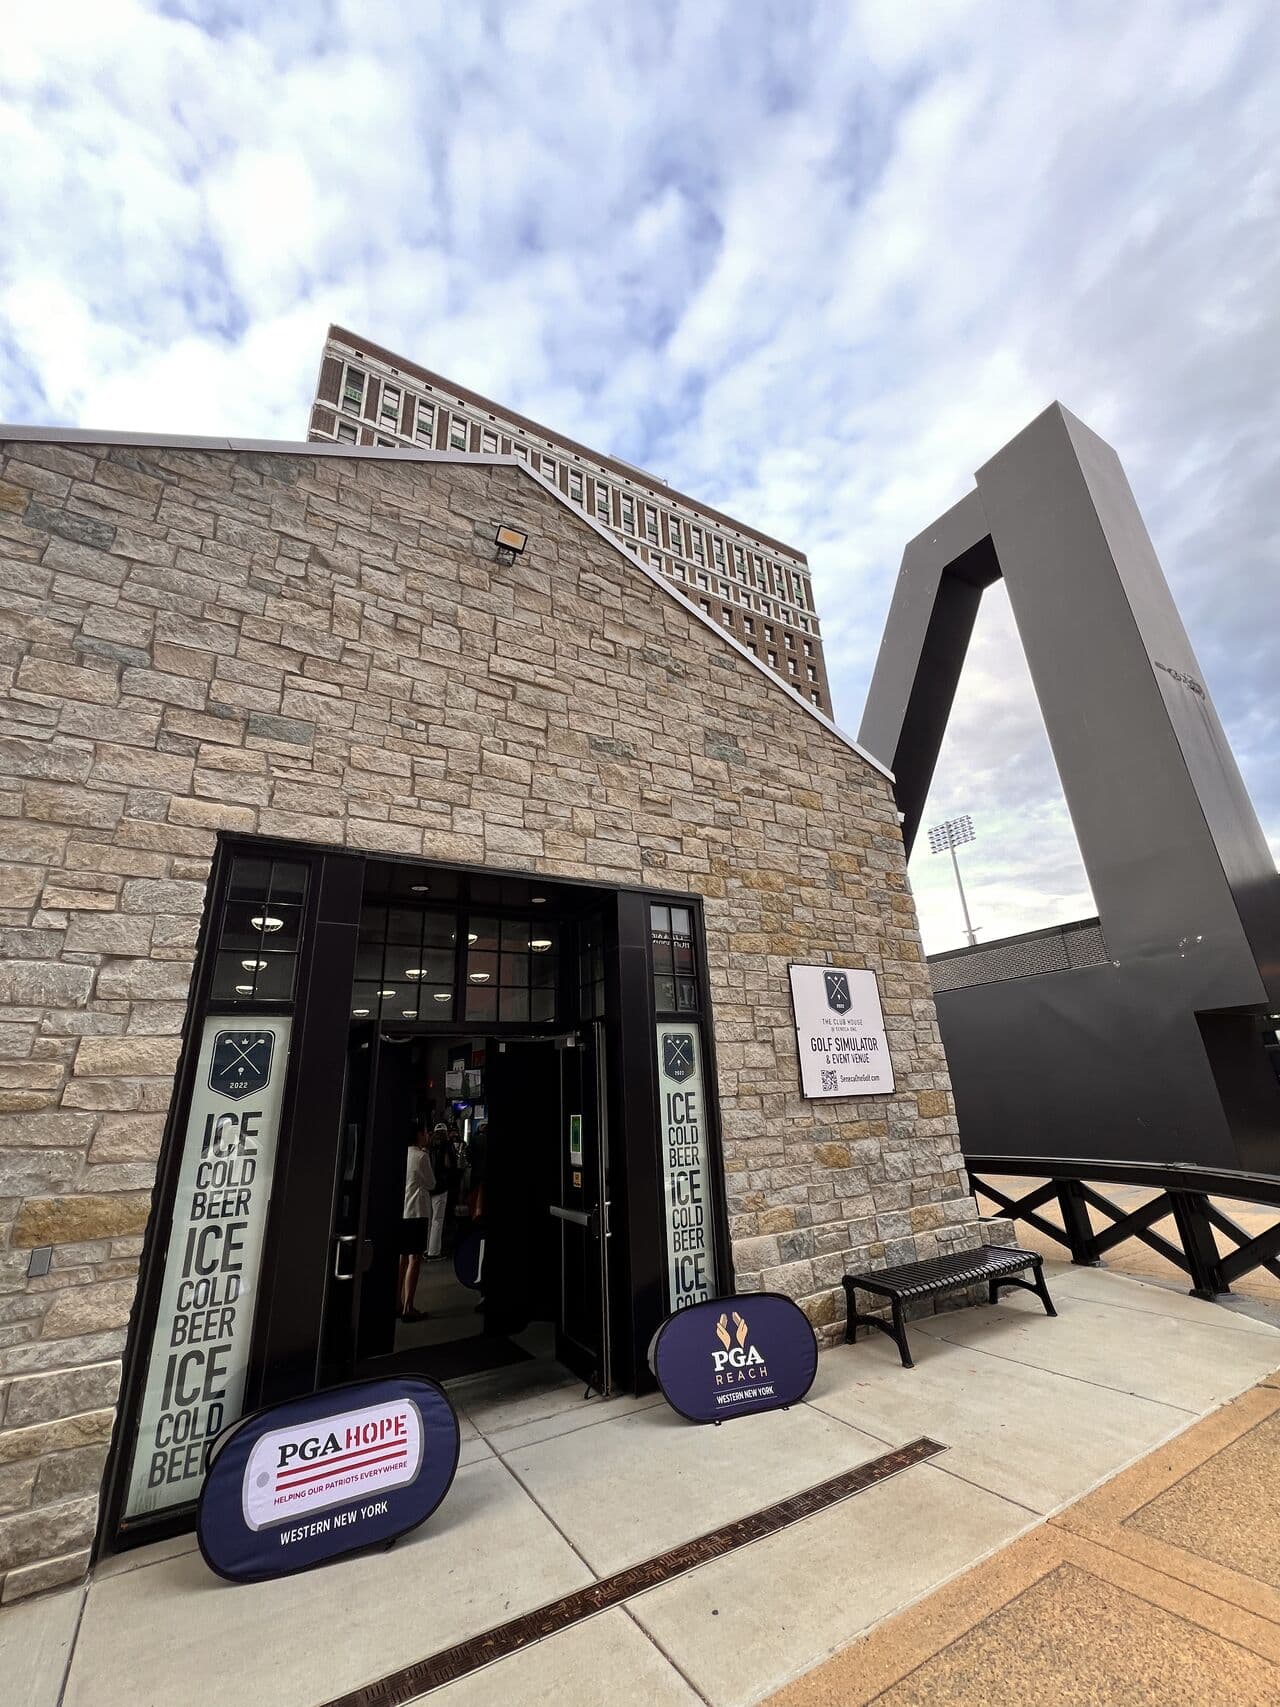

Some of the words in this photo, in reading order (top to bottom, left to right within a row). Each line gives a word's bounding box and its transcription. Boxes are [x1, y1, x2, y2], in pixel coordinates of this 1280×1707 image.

[810, 1037, 833, 1052] GOLF
[834, 1037, 879, 1052] SIMULATOR
[825, 1054, 831, 1065] &
[831, 1053, 851, 1064] EVENT
[850, 1053, 870, 1064] VENUE
[229, 1081, 248, 1089] 2022
[666, 1091, 698, 1125] ICE
[200, 1111, 263, 1160] ICE
[668, 1125, 699, 1147] COLD
[669, 1145, 700, 1168] BEER
[195, 1158, 257, 1190] COLD
[670, 1169, 703, 1207] ICE
[190, 1188, 252, 1221] BEER
[672, 1205, 703, 1230] COLD
[181, 1222, 248, 1279] ICE
[673, 1227, 704, 1253] BEER
[674, 1252, 707, 1295] ICE
[176, 1274, 241, 1313] COLD
[170, 1307, 237, 1348] BEER
[711, 1345, 765, 1372] PGA
[160, 1343, 233, 1412] ICE
[715, 1366, 768, 1386] REACH
[716, 1393, 744, 1405] WESTERN
[744, 1389, 759, 1400] NEW
[758, 1385, 774, 1397] YORK
[154, 1402, 225, 1450] COLD
[276, 1432, 343, 1469] PGA
[345, 1414, 408, 1450] HOPE
[273, 1488, 307, 1506] HELPING
[307, 1483, 324, 1496] OUR
[324, 1473, 359, 1491] PATRIOTS
[360, 1461, 408, 1480] EVERYWHERE
[280, 1518, 331, 1546] WESTERN
[333, 1510, 358, 1530] NEW
[361, 1500, 389, 1521] YORK
